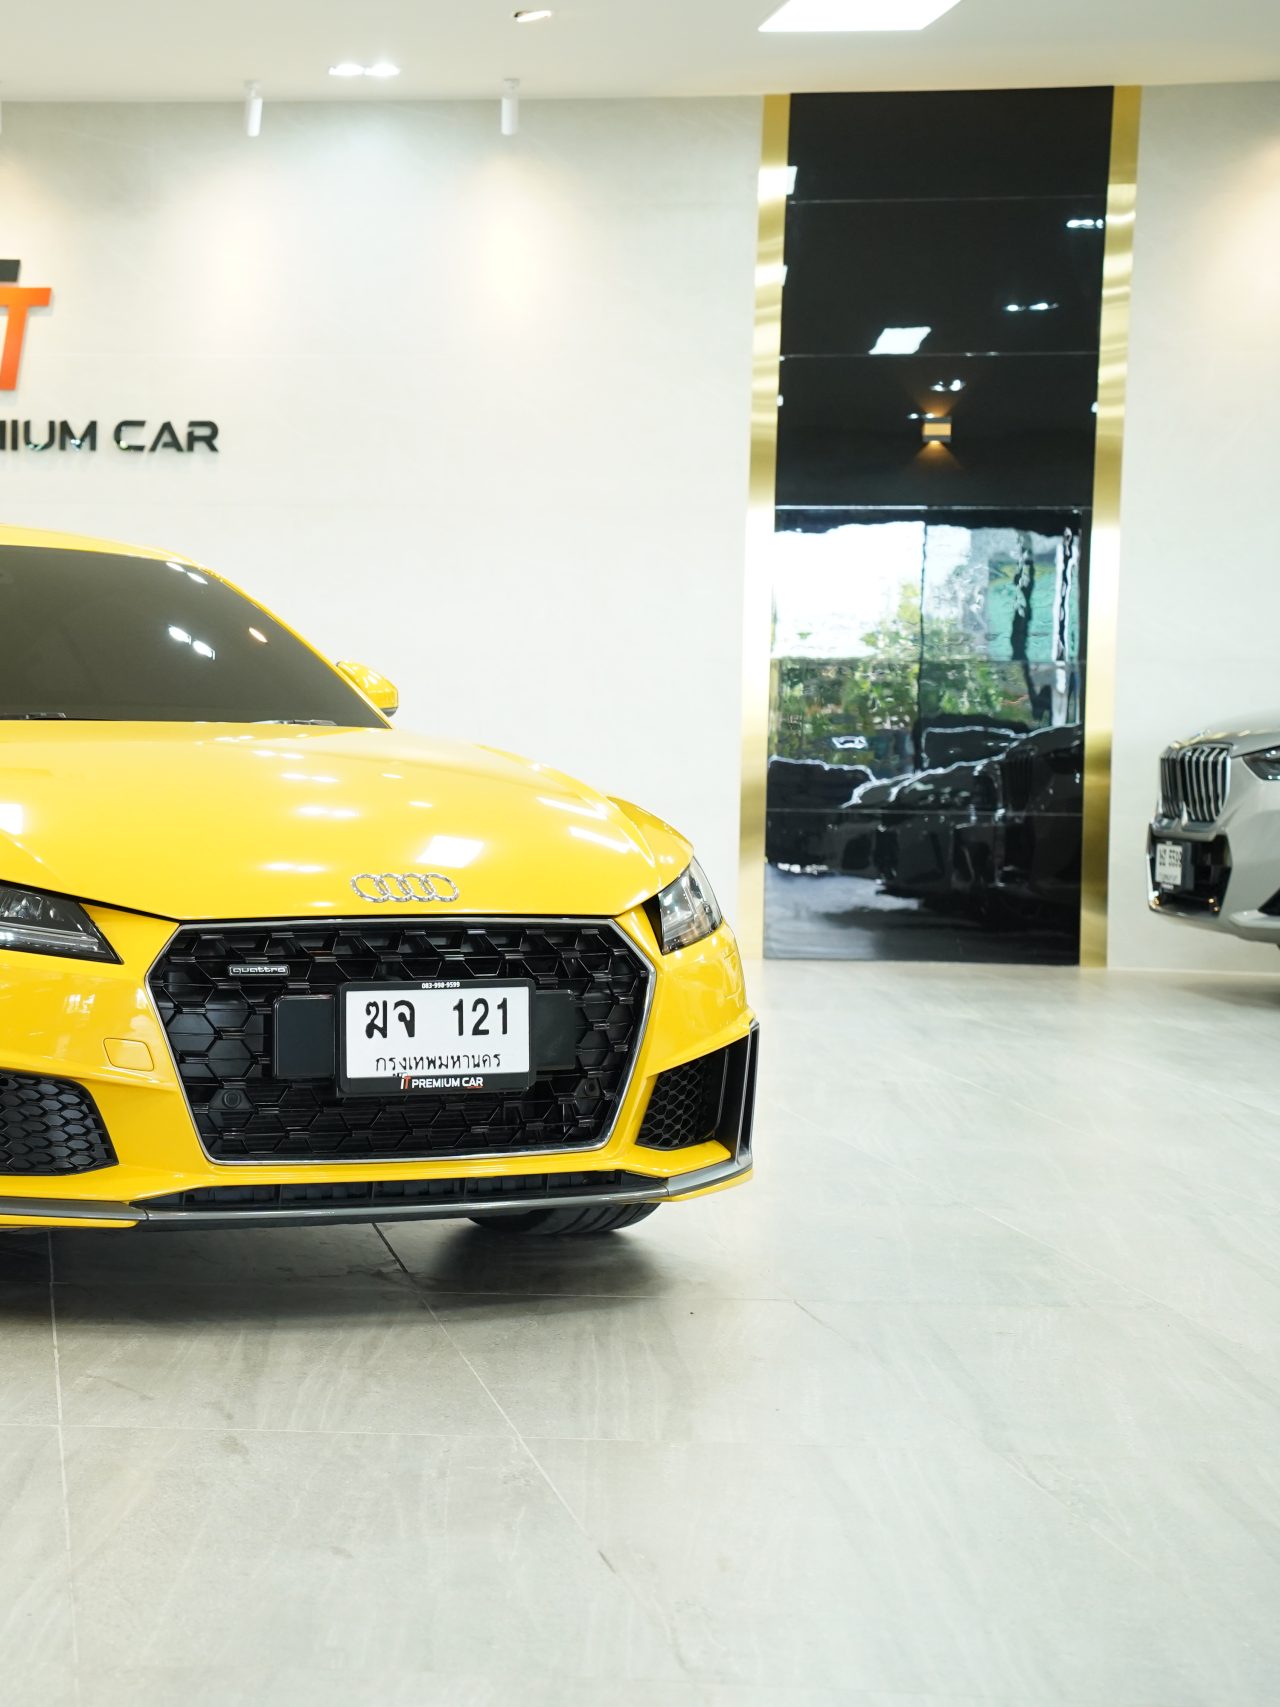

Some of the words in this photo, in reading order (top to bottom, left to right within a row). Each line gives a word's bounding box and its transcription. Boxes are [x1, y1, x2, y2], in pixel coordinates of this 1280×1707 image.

[113, 420, 220, 453] CAR
[232, 966, 286, 974] quattro
[452, 997, 508, 1037] 121
[411, 1077, 460, 1089] PREMIUM
[461, 1076, 484, 1088] CAR
